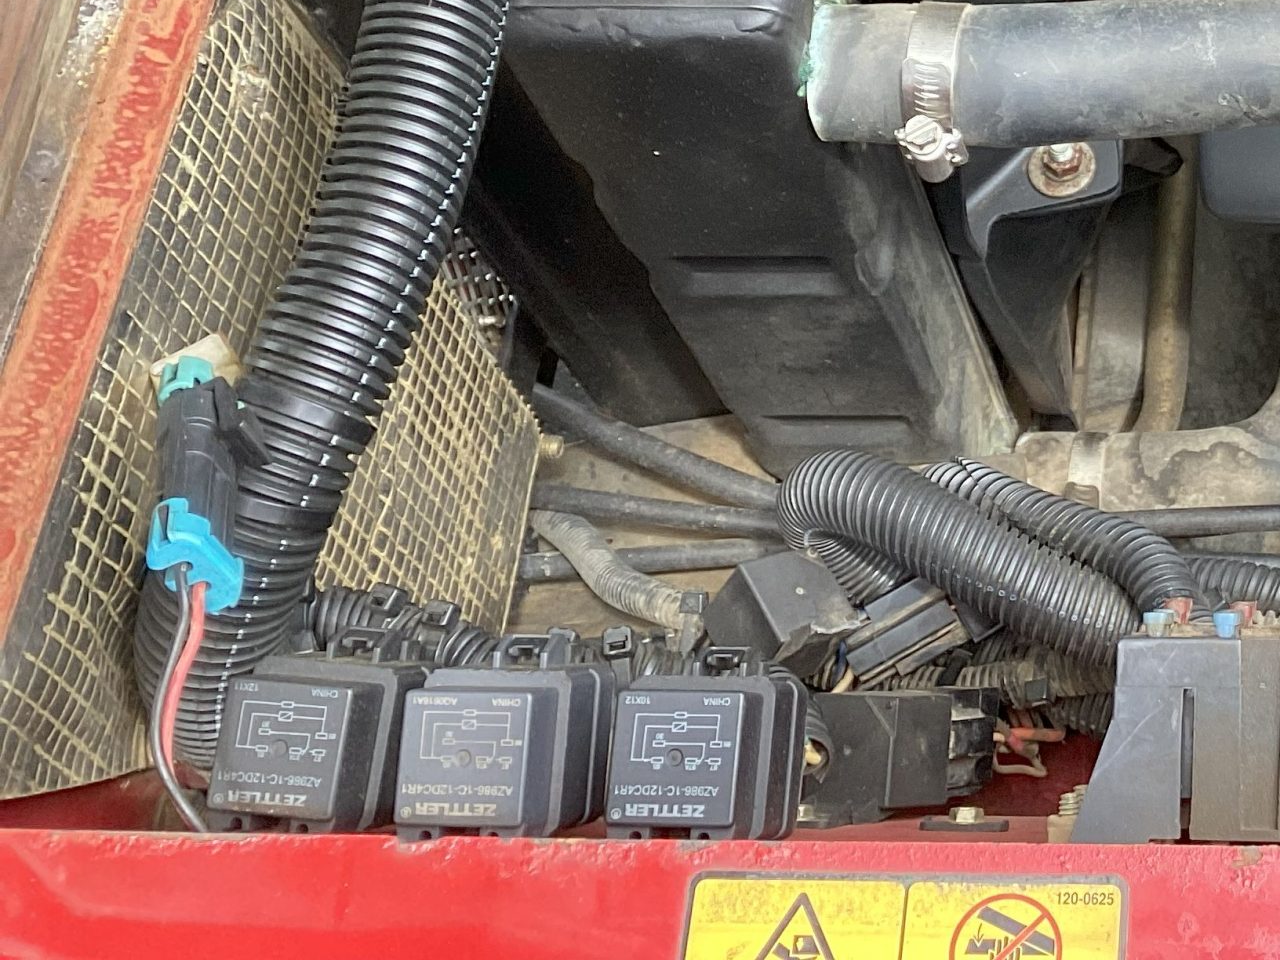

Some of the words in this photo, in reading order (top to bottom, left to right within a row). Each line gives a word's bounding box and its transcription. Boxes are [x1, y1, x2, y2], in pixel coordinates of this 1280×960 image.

[311, 687, 339, 699] CHINA
[491, 697, 522, 707] CHINA
[703, 696, 731, 706] CHINA
[227, 789, 308, 807] ZETTLER
[415, 801, 497, 817] ZETTLER
[625, 803, 706, 818] ZETTLER
[1056, 891, 1115, 906] 120-0625
